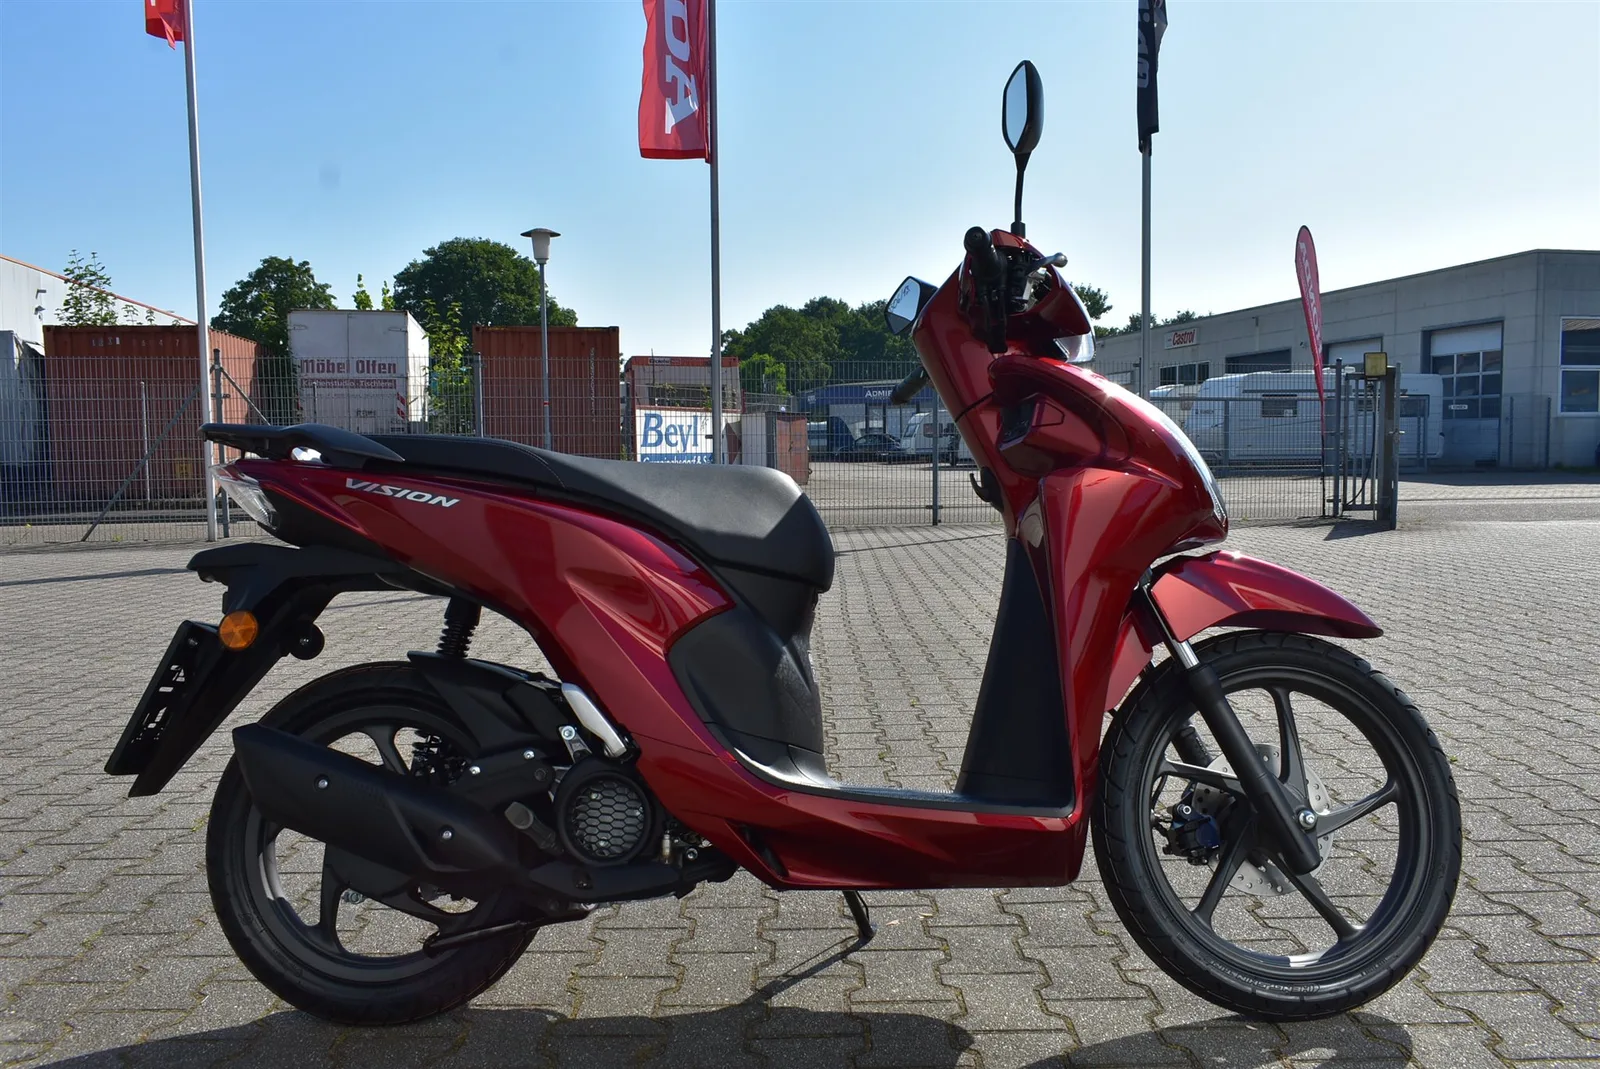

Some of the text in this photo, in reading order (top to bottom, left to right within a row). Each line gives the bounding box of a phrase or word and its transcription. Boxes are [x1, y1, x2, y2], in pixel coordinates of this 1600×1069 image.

[1173, 329, 1196, 346] Castrol
[300, 359, 397, 374] Möbel Olfen
[640, 413, 699, 452] Beyl
[345, 477, 460, 508] VISION
